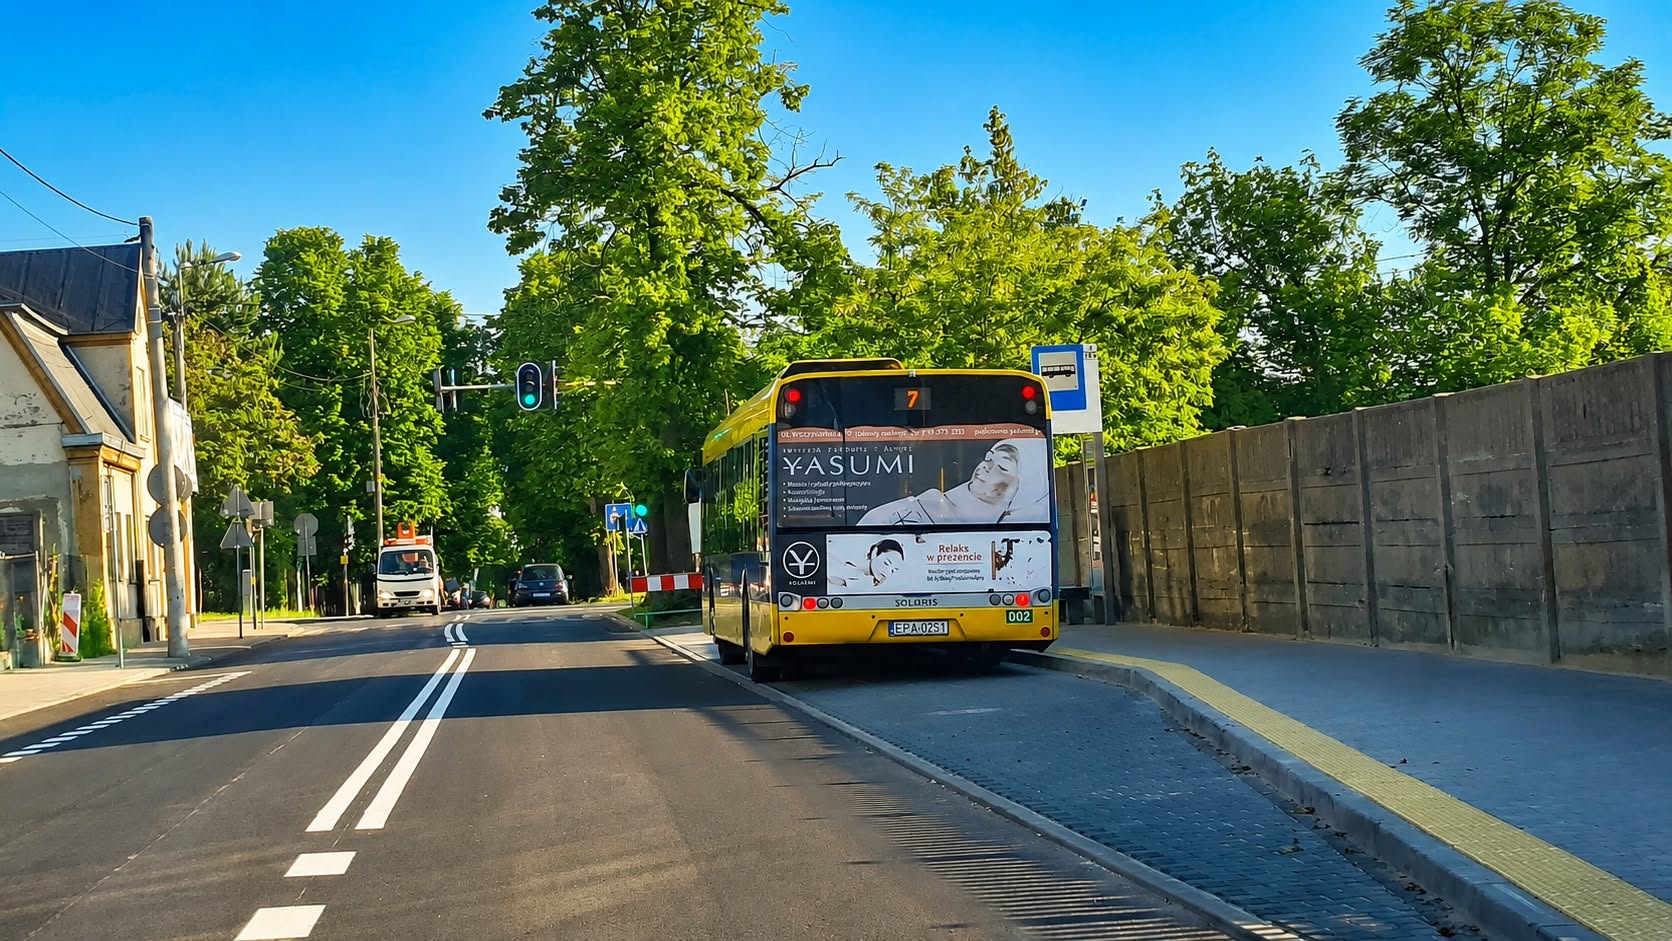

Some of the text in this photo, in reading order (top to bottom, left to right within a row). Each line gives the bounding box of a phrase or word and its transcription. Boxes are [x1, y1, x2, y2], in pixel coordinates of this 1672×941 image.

[907, 390, 919, 408] 7
[783, 454, 913, 476] YASUMI
[938, 544, 969, 553] Relaks
[937, 551, 982, 563] prezencie
[1008, 611, 1031, 622] 002
